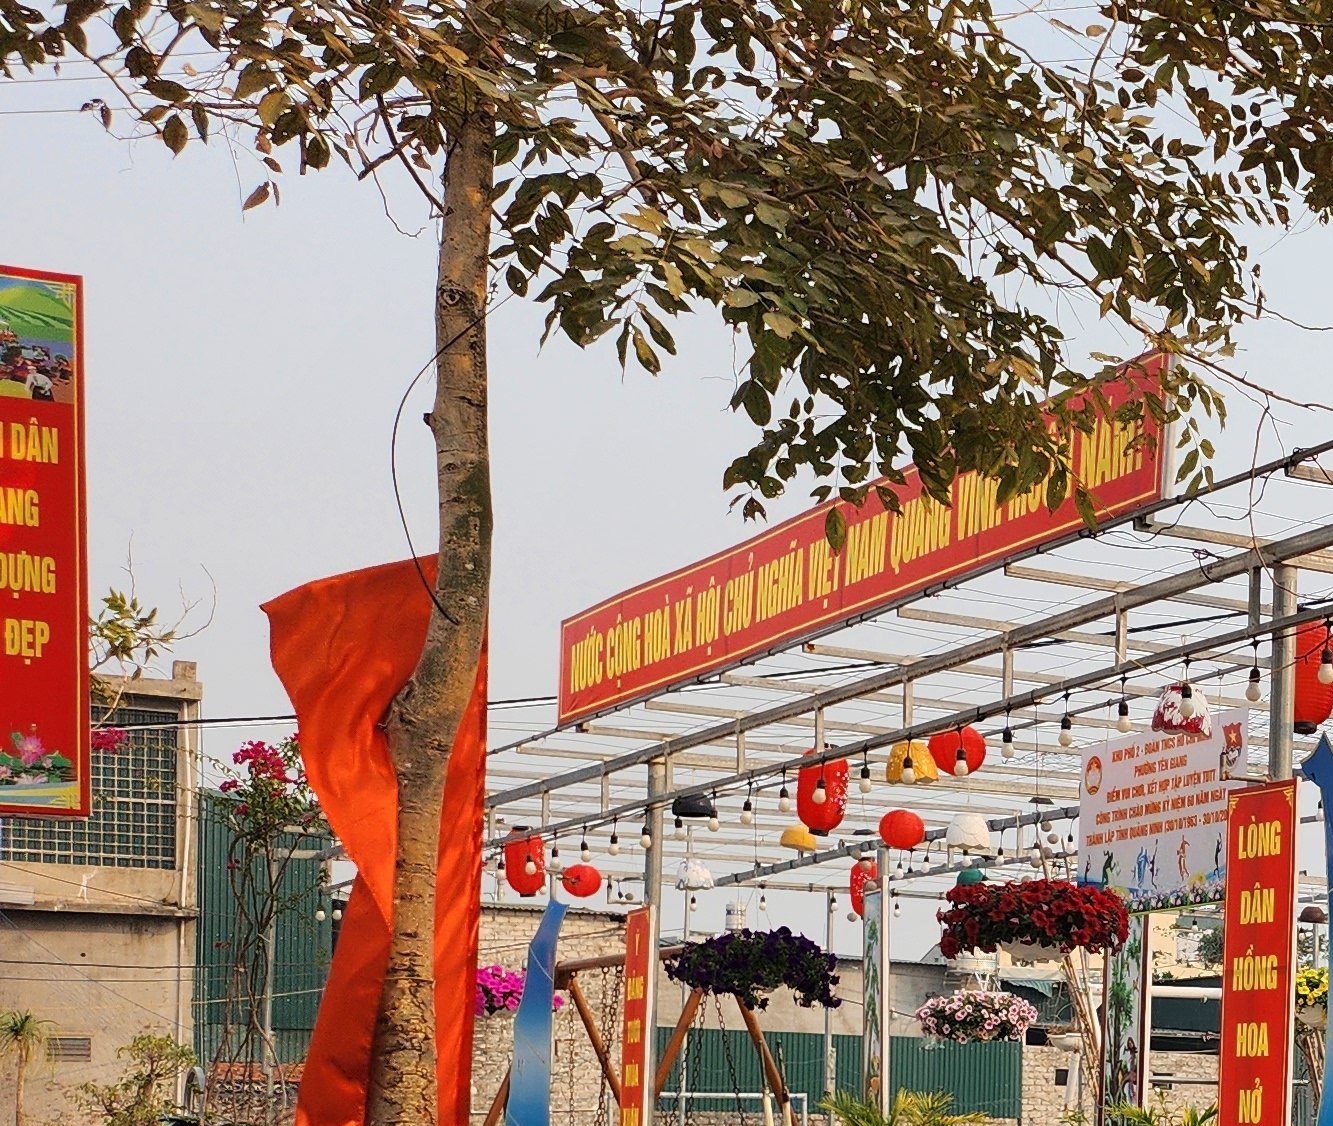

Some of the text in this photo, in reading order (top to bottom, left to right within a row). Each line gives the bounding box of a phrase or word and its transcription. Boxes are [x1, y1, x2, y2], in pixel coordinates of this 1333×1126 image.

[10, 416, 59, 465] DÂN
[570, 626, 603, 694] NƯỚC
[606, 613, 641, 688] CỘNG
[644, 594, 671, 666] HOÀ
[674, 585, 694, 656] XÃ
[696, 575, 721, 656] HỘI
[723, 552, 755, 637] CHỦ
[755, 539, 804, 623] NGHĨA
[844, 510, 889, 587] NAM
[890, 483, 953, 575] QUANG
[4, 618, 50, 666] ĐẸP
[1238, 815, 1282, 860] LÒNG
[1239, 881, 1275, 926] DÂN
[1232, 944, 1279, 992] HỒNG
[1236, 1022, 1270, 1058] HOA
[1238, 1077, 1263, 1124] NỞ
